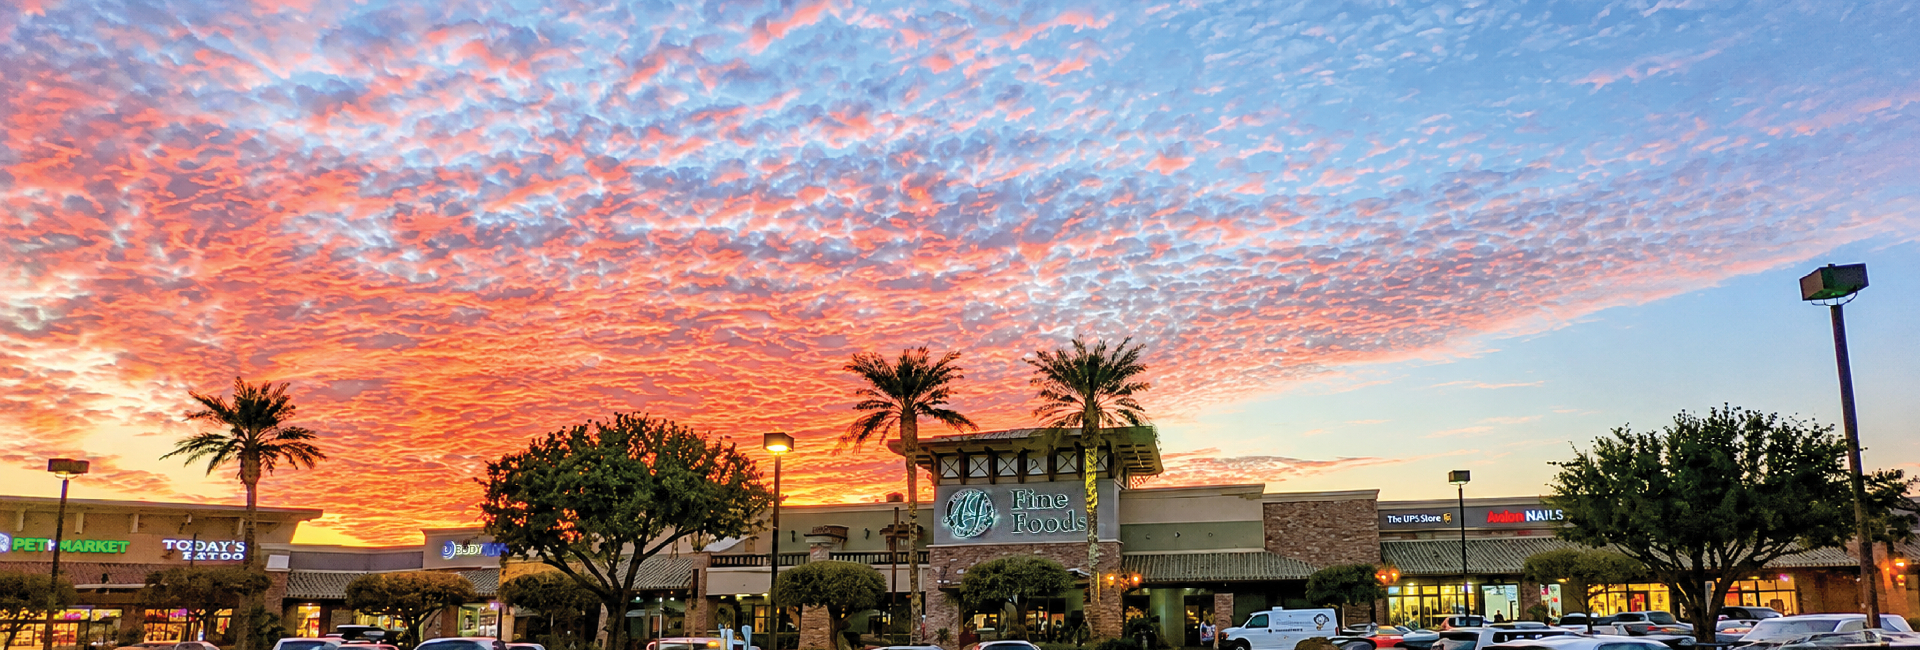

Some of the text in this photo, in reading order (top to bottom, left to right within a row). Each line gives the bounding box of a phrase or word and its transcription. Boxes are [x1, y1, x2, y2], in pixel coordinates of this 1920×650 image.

[1010, 488, 1068, 510] Fine
[1010, 509, 1087, 533] Foods
[1387, 515, 1402, 523] The
[1403, 514, 1420, 523] UPS
[1420, 514, 1442, 523] Store
[1525, 509, 1564, 522] NAILS
[60, 540, 130, 553] MARKET
[162, 539, 245, 553] TODAY'S
